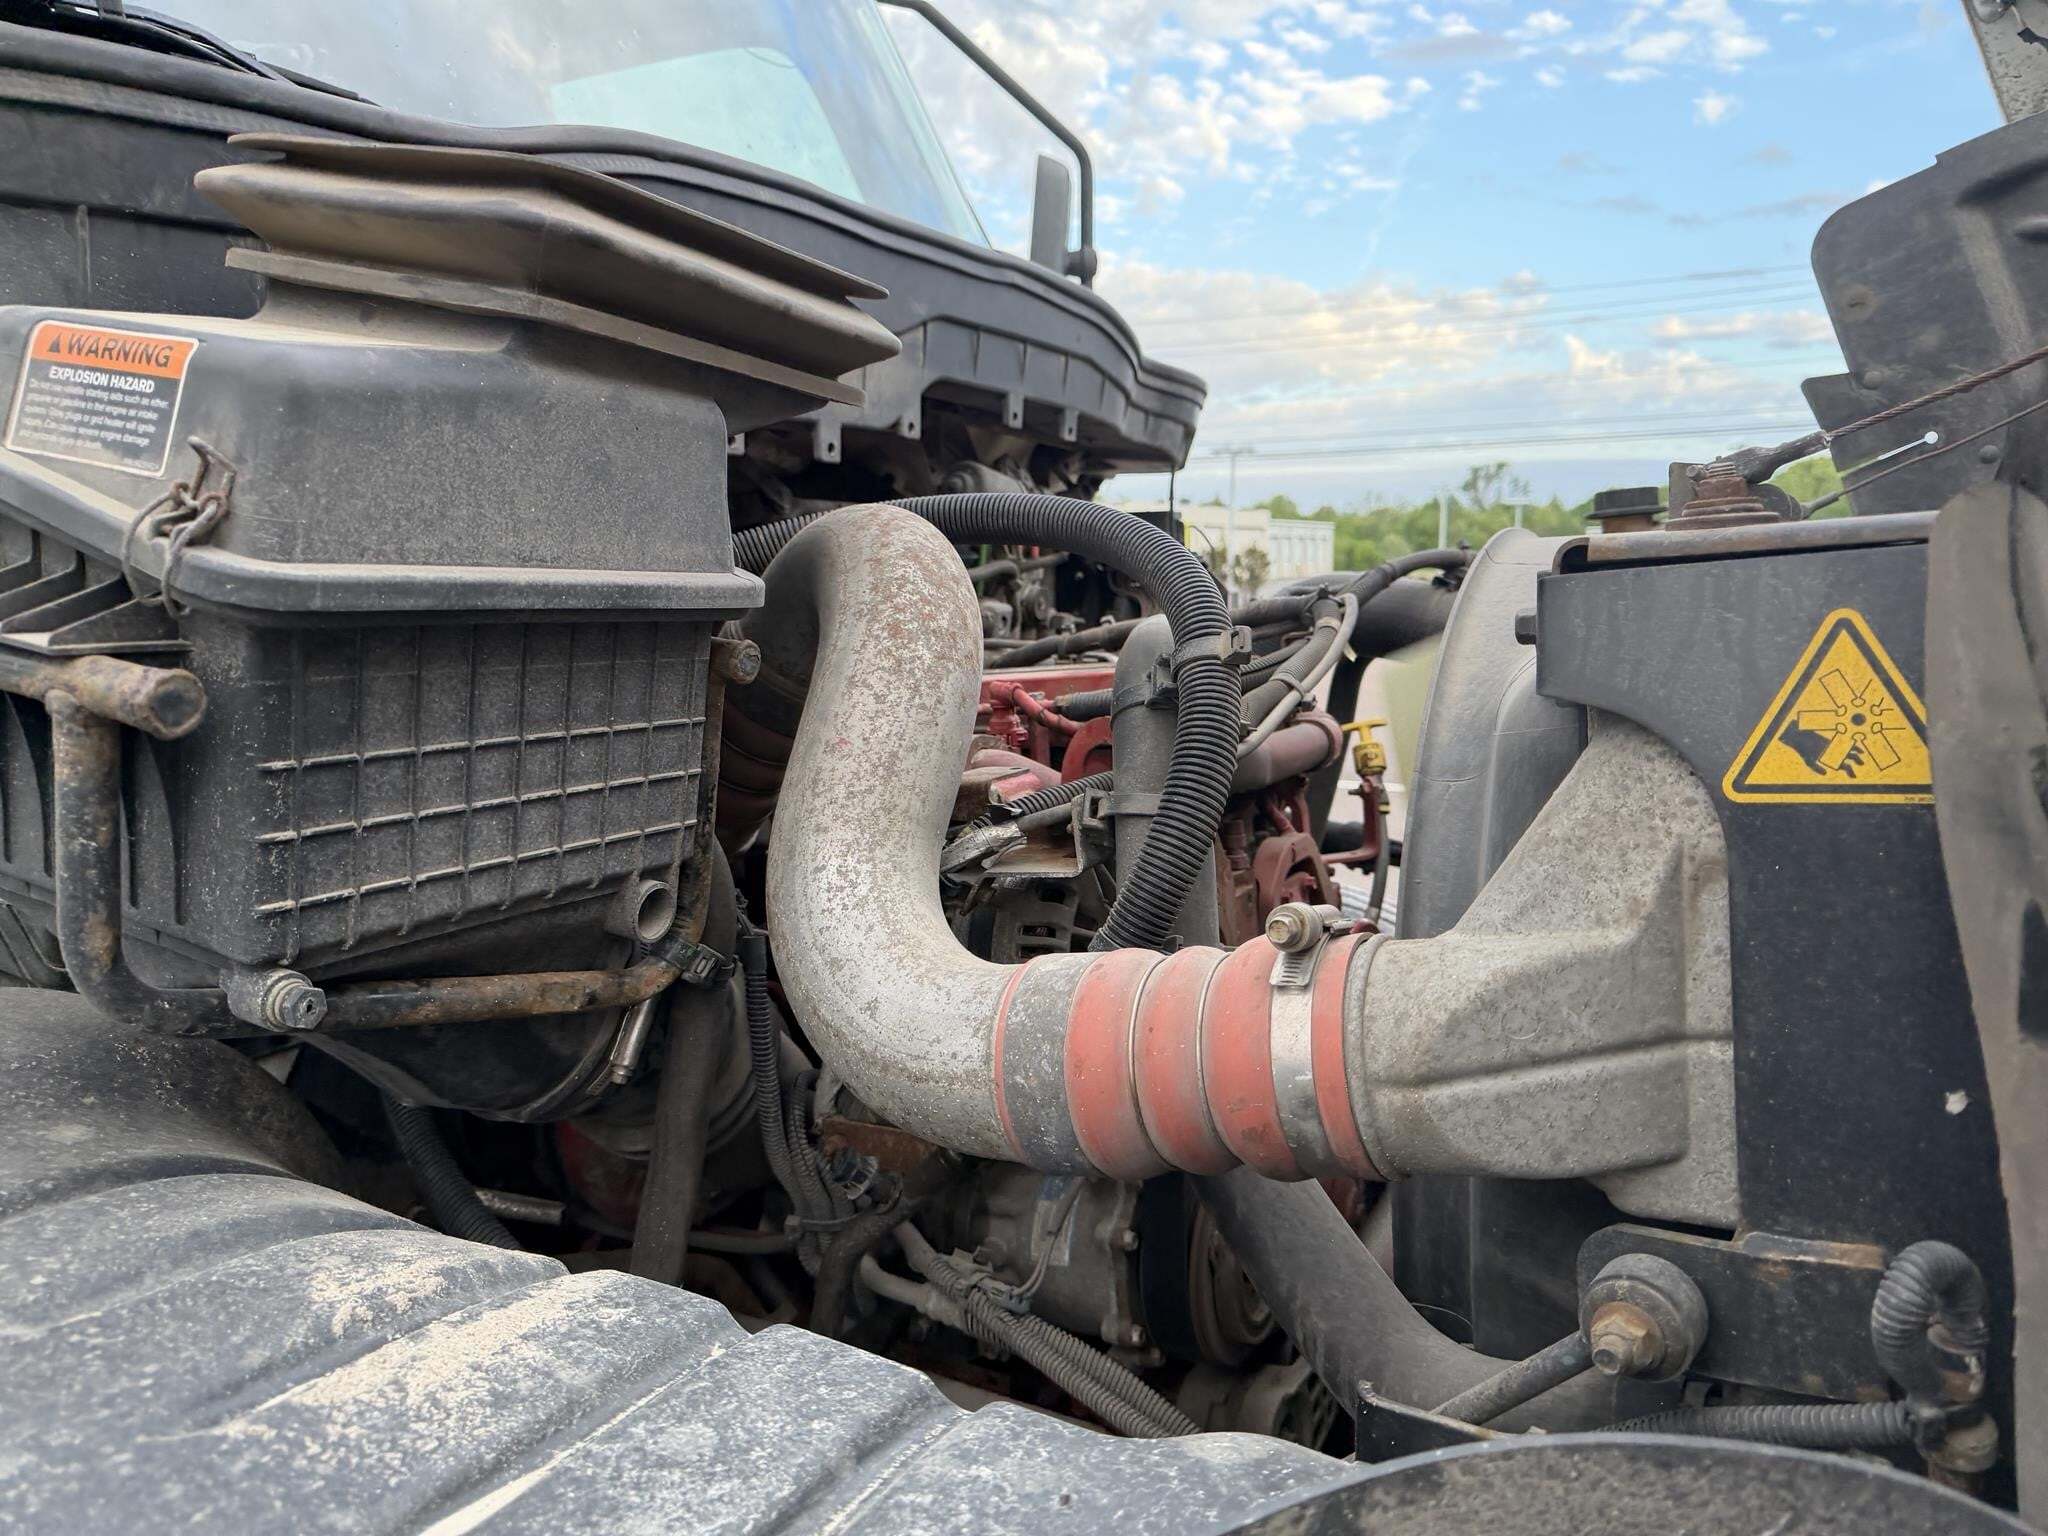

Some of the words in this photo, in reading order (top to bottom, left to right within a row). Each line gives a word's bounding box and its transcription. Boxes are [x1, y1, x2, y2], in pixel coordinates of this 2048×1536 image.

[66, 333, 173, 367] WARNING
[49, 366, 109, 386] EXPLOSION
[110, 375, 155, 393] HAZARD
